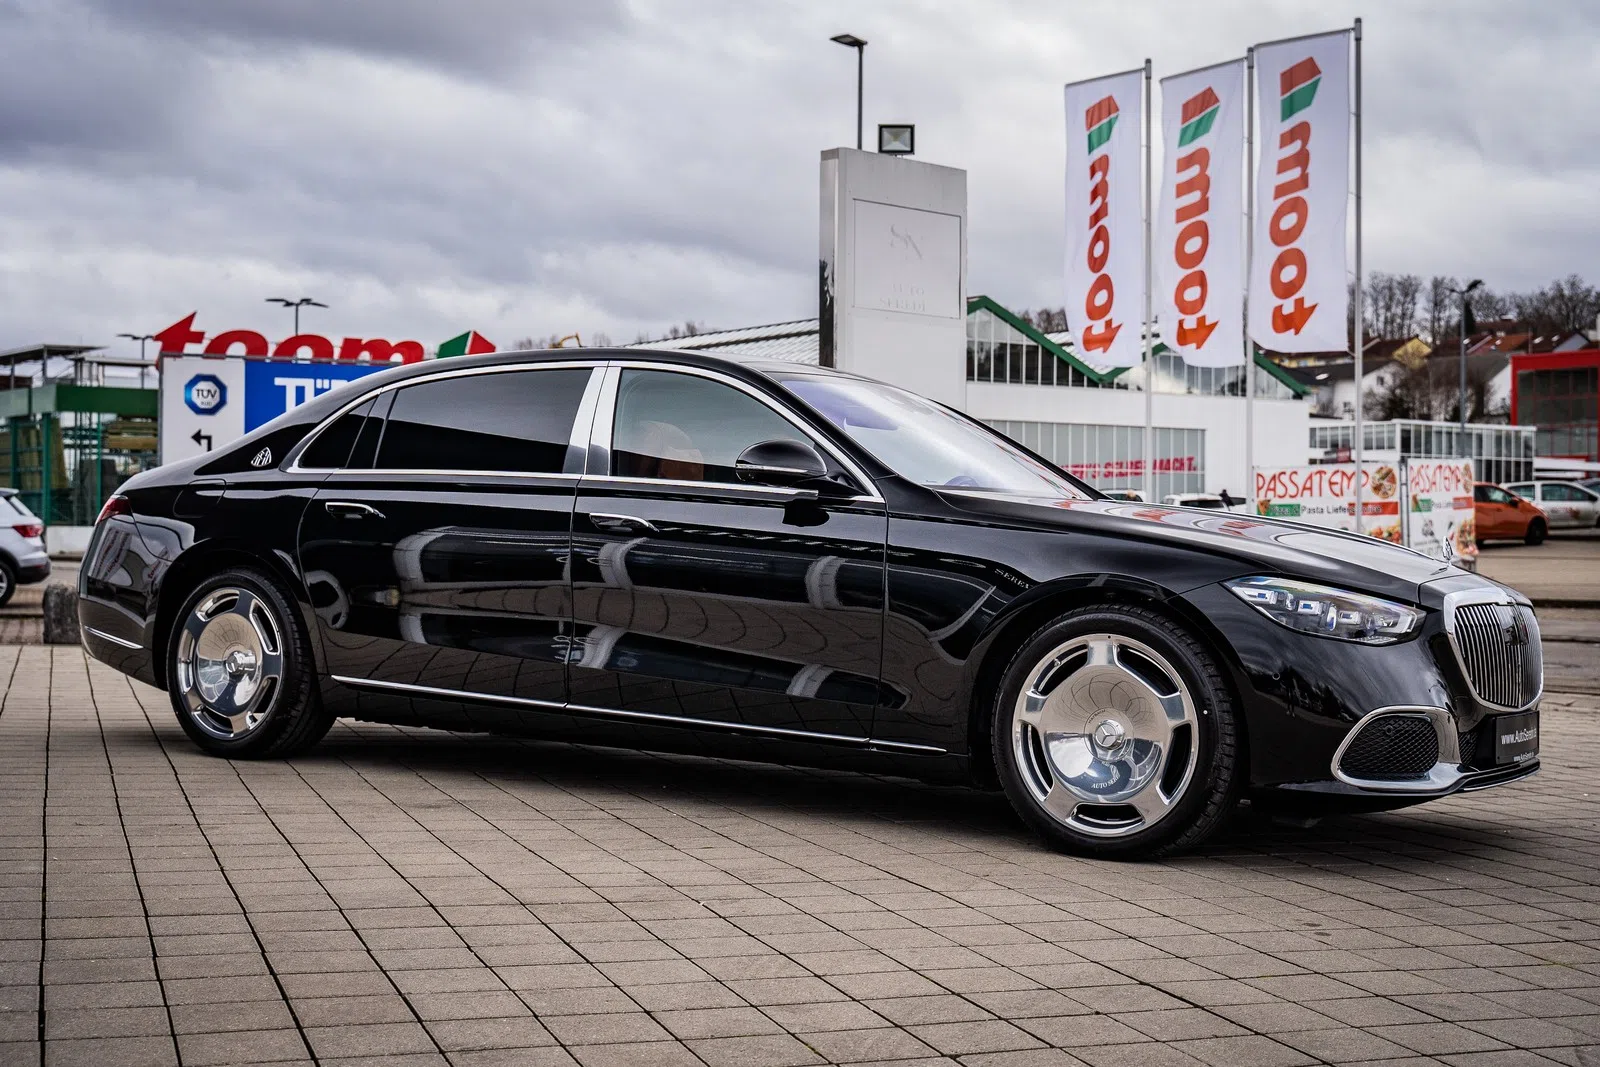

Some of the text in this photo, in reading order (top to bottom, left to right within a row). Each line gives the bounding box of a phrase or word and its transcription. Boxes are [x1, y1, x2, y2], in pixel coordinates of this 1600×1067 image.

[1082, 154, 1123, 354] toom
[1174, 147, 1220, 350] toom
[1269, 121, 1319, 336] toom
[273, 376, 348, 412] TÜ
[1301, 506, 1324, 514] Pasta
